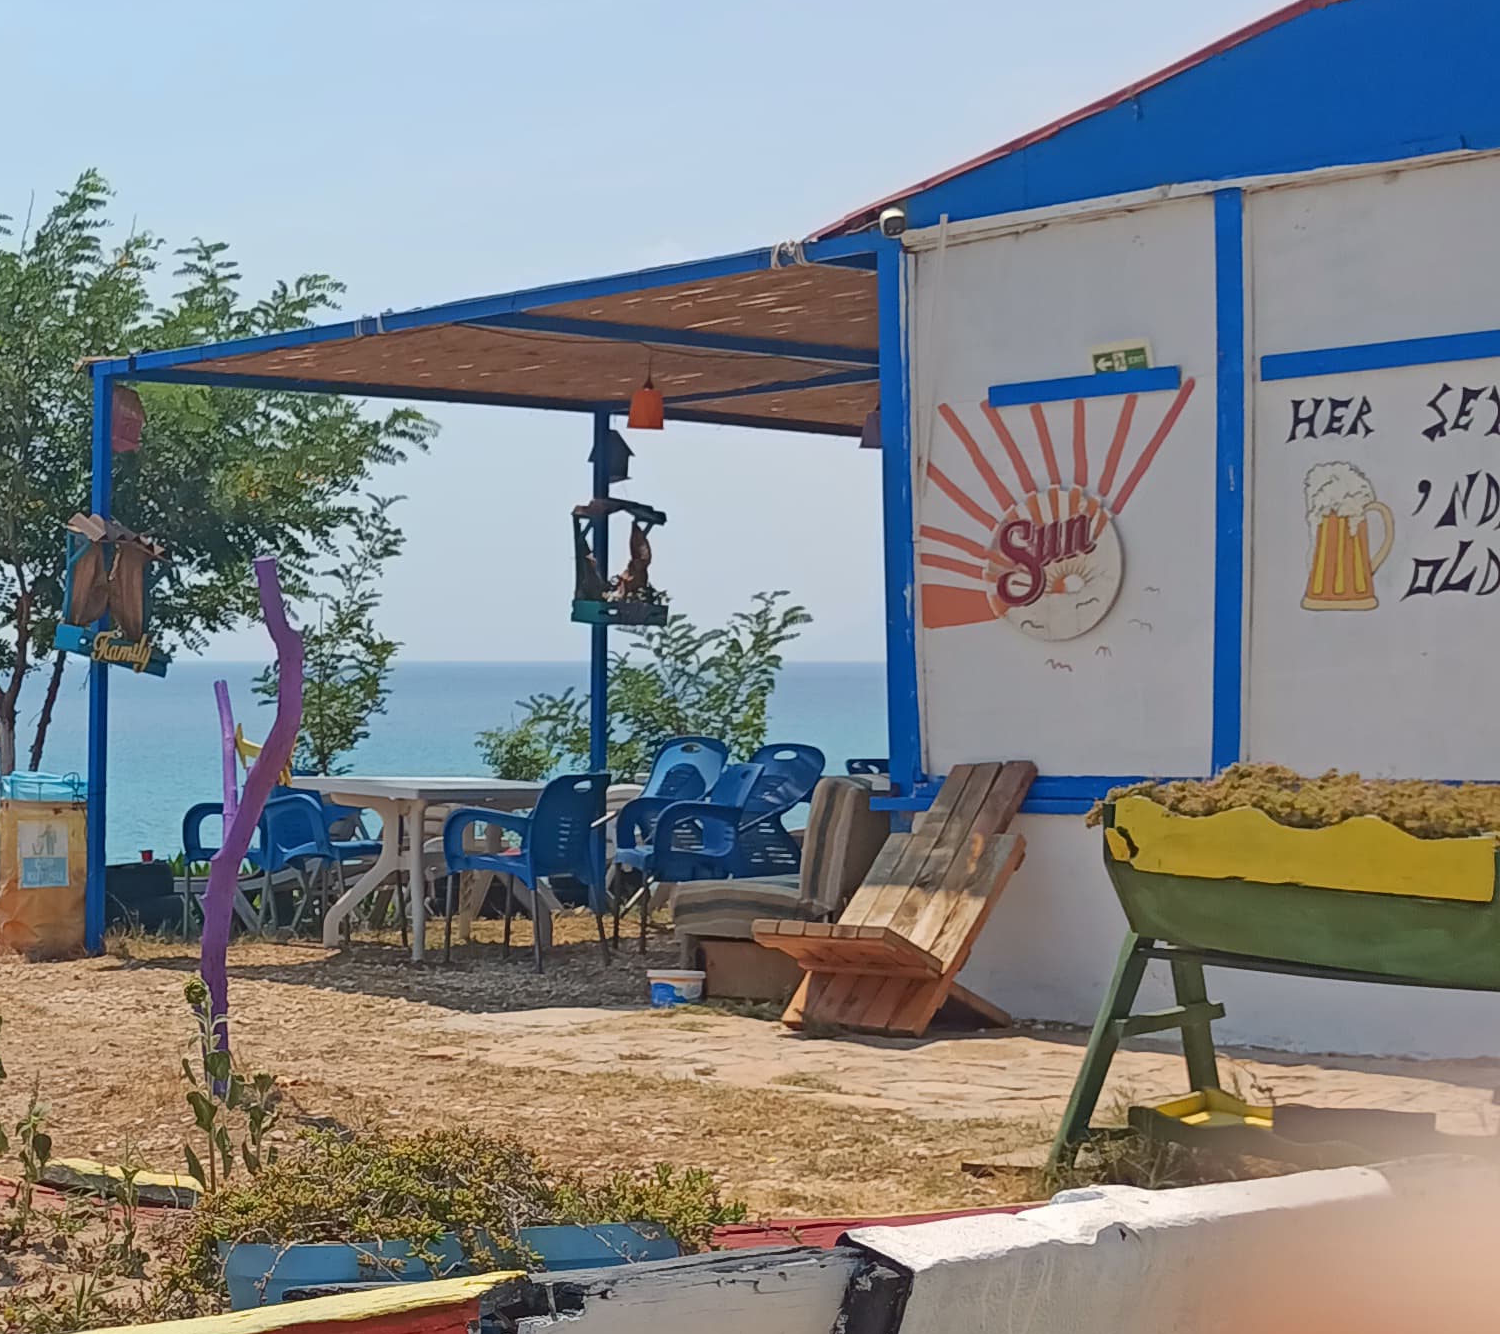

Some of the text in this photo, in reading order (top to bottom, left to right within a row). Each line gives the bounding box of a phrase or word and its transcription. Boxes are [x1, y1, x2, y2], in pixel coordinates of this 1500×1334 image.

[1285, 395, 1375, 443] HER
[1411, 469, 1500, 530] 'ND
[997, 514, 1097, 607] Sun
[91, 630, 152, 674] Family
